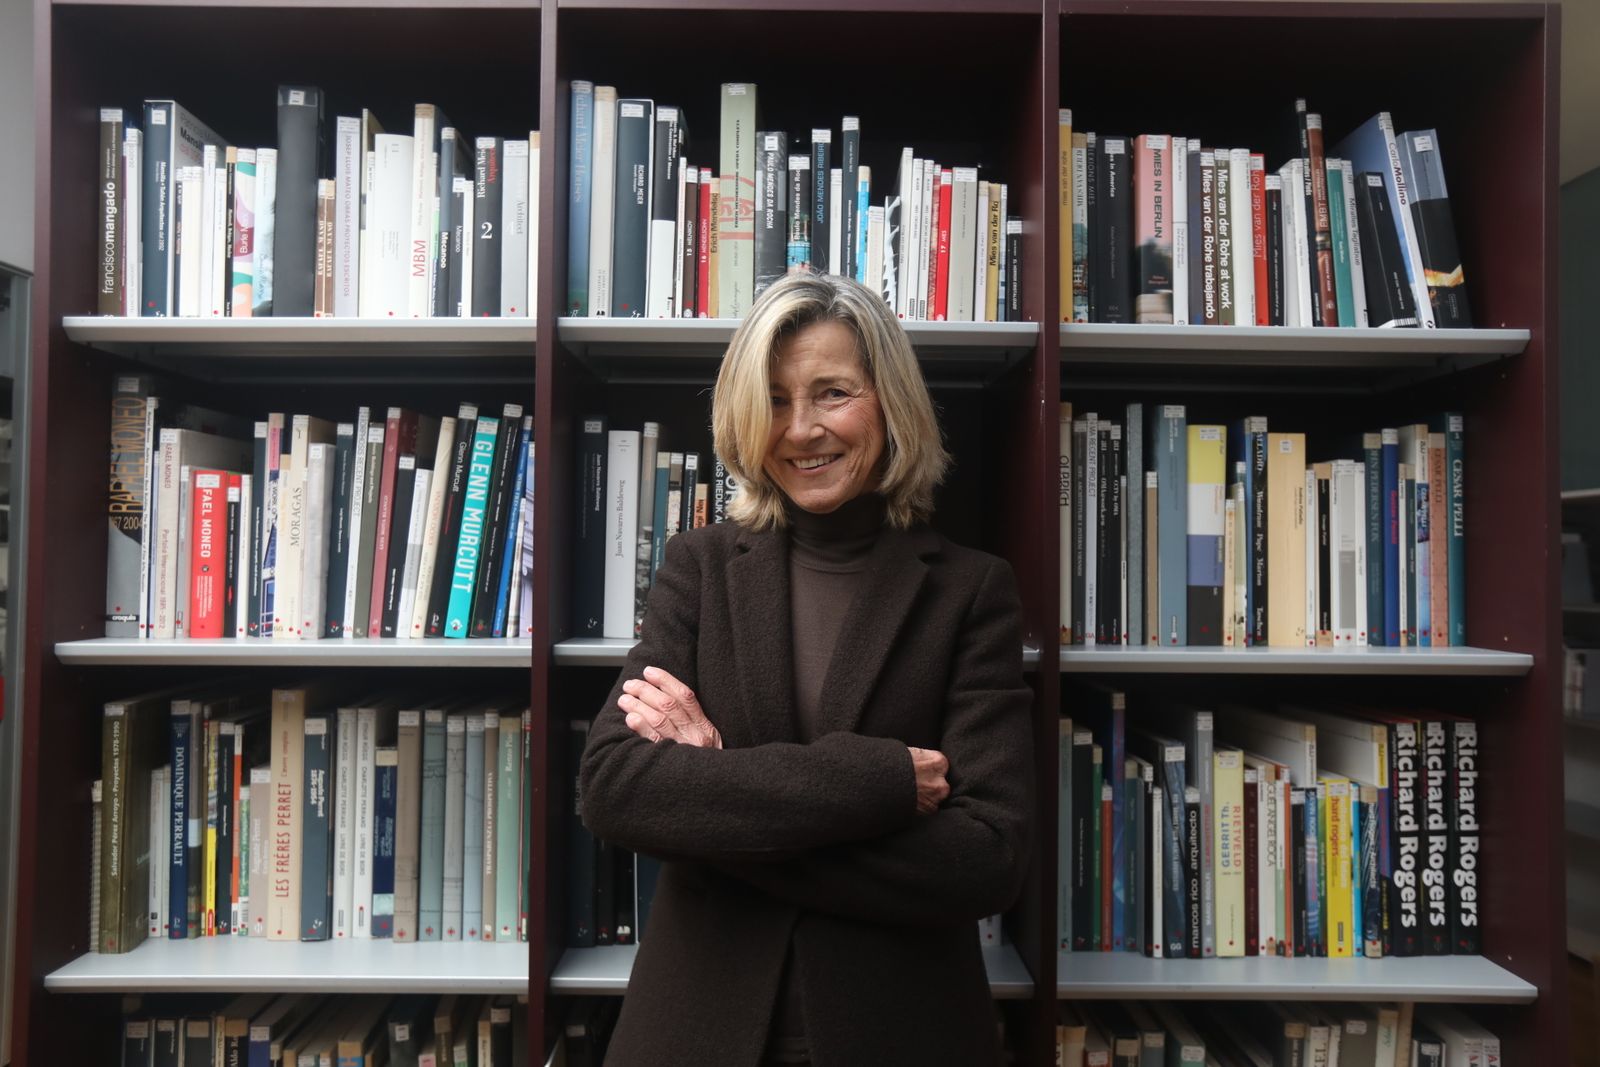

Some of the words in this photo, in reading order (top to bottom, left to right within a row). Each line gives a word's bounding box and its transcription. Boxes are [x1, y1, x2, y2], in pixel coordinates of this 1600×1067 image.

[637, 165, 645, 187] RICHARD
[766, 152, 774, 172] PAULO
[1153, 148, 1162, 176] MIES
[477, 167, 486, 198] Richard
[766, 173, 774, 197] MENDES
[795, 183, 801, 191] da
[817, 170, 825, 202] MENDES
[1154, 181, 1162, 191] IN
[1202, 169, 1212, 193] Mies
[1217, 169, 1228, 194] Mies
[766, 199, 774, 207] DA
[1203, 195, 1212, 215] van
[1218, 197, 1227, 216] van
[1252, 193, 1261, 211] der
[481, 221, 493, 239] 2
[766, 208, 774, 229] ROCHA
[793, 221, 801, 240] Paulo
[990, 214, 998, 227] der
[1154, 196, 1162, 238] BERLIN
[1203, 216, 1214, 234] der
[1219, 218, 1229, 236] der
[1253, 213, 1261, 231] van
[102, 182, 117, 293] franciscomangado
[440, 232, 449, 268] Mecanoo
[455, 225, 463, 252] Mecanoo
[941, 245, 947, 253] 17
[1204, 235, 1215, 263] Rohe
[1252, 233, 1263, 258] Mies
[413, 240, 426, 277] MBM
[989, 247, 997, 266] Mies
[1219, 239, 1230, 267] Rohe
[1220, 269, 1229, 280] at
[1204, 264, 1219, 319] trabajando
[1221, 282, 1231, 309] work
[111, 396, 146, 451] MONEO
[457, 442, 467, 463] Glenn
[1088, 437, 1096, 464] RECENT
[164, 464, 172, 489] MONEO
[452, 465, 464, 492] Murcutt
[467, 440, 493, 500] GLENN
[1088, 467, 1096, 497] PROJECT
[1453, 459, 1463, 498] CESAR
[109, 458, 144, 513] RAFAEL
[617, 480, 626, 511] Baldeweg
[715, 479, 723, 513] RIEDIJK
[1370, 470, 1378, 519] PEDERSEN
[290, 487, 302, 547] MORAGAS
[1454, 502, 1463, 537] PELLI
[200, 519, 211, 558] MONEO
[1255, 533, 1264, 551] Pape
[1371, 522, 1379, 542] FOX
[453, 507, 482, 592] MURCUTT
[615, 541, 624, 558] Juan
[1256, 607, 1264, 636] Taschen
[112, 758, 120, 792] Proyectos
[505, 750, 514, 772] Renzo
[174, 746, 185, 809] DOMINIQUE
[316, 769, 325, 795] Auguste
[1397, 730, 1419, 832] Richard
[1426, 730, 1447, 830] Richard
[1457, 731, 1479, 831] Richard
[112, 798, 120, 823] Arroyo
[278, 782, 291, 826] PERRET
[1220, 801, 1230, 819] Th.
[173, 811, 184, 867] PERRAULT
[252, 819, 261, 841] Perret
[1188, 810, 1199, 870] arquitecto
[1221, 821, 1230, 867] GERRIT
[1233, 806, 1242, 868] RIETVELD
[1330, 825, 1339, 856] rogers
[111, 845, 119, 876] Salvador
[252, 844, 261, 874] Auguste
[1267, 840, 1276, 867] ROCA
[1369, 852, 1377, 888] Architects
[1393, 836, 1419, 928] Rogers
[1422, 835, 1447, 926] Rogers
[1453, 836, 1479, 927] Rogers
[276, 879, 289, 898] LES
[1190, 878, 1198, 901] rico
[1190, 903, 1199, 948] marcos
